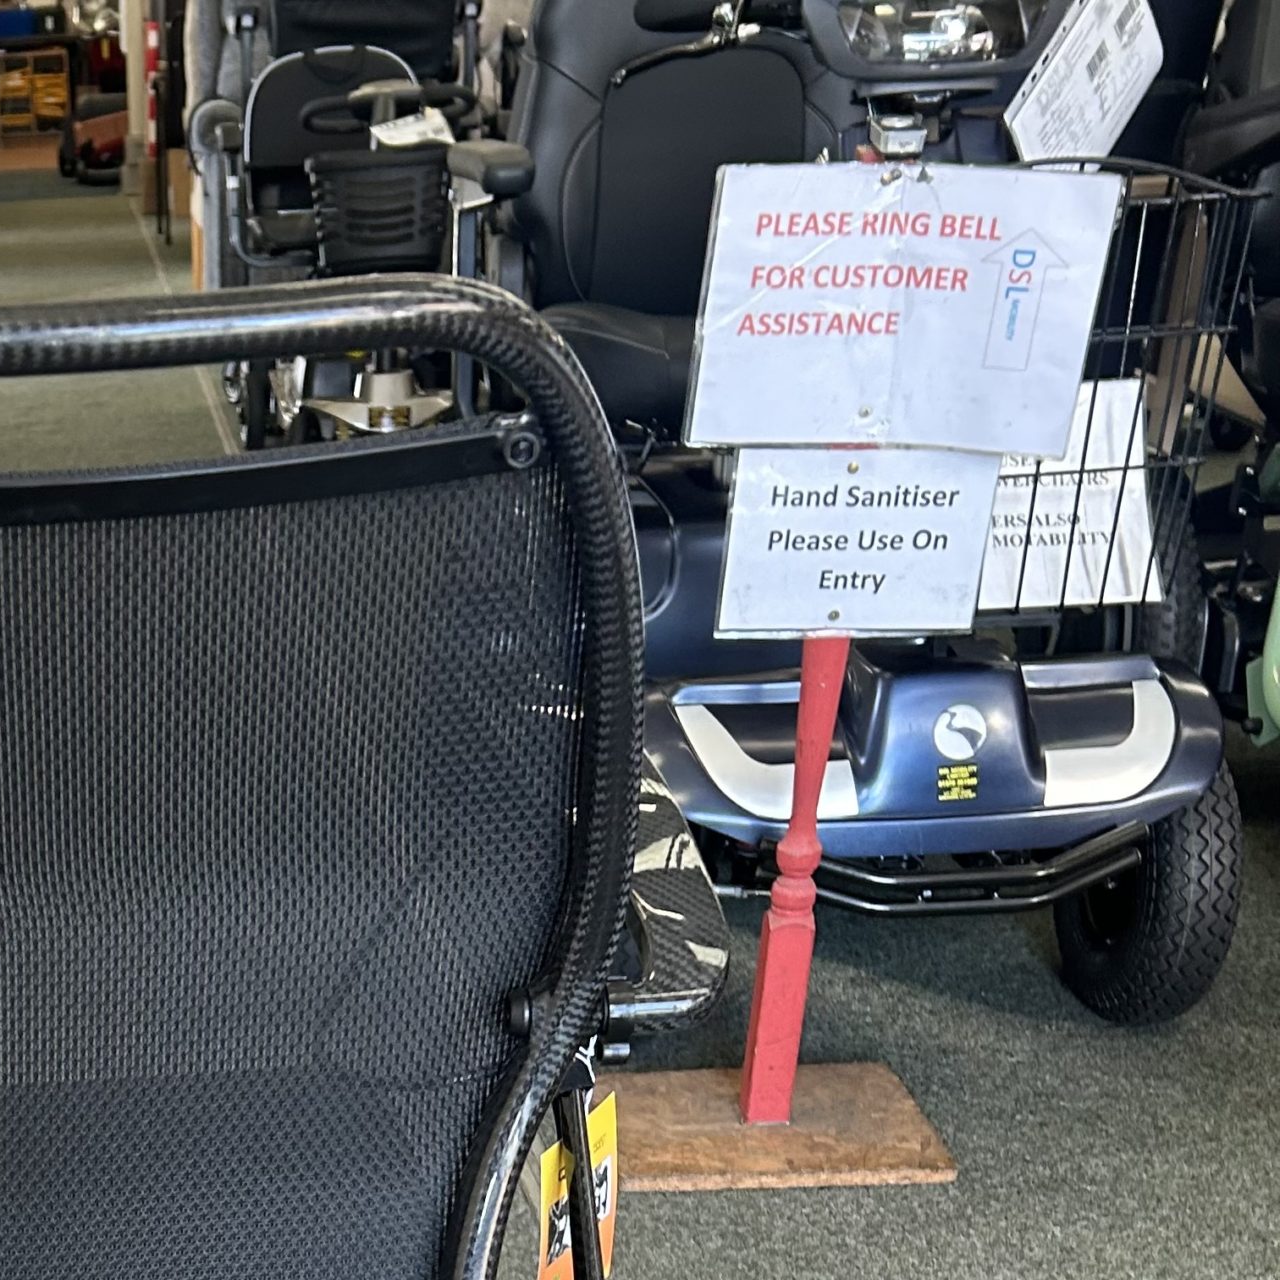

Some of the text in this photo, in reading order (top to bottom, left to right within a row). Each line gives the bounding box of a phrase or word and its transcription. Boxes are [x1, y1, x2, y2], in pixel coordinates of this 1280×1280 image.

[755, 211, 1002, 241] PLEASE RING BELL
[750, 264, 969, 292] FOR CUSTOMER
[1004, 249, 1037, 300] DSL
[737, 312, 901, 336] ASSISTANCE
[771, 484, 960, 508] Hand Sanitiser
[768, 529, 949, 551] Please Use On
[819, 569, 887, 595] Entry
